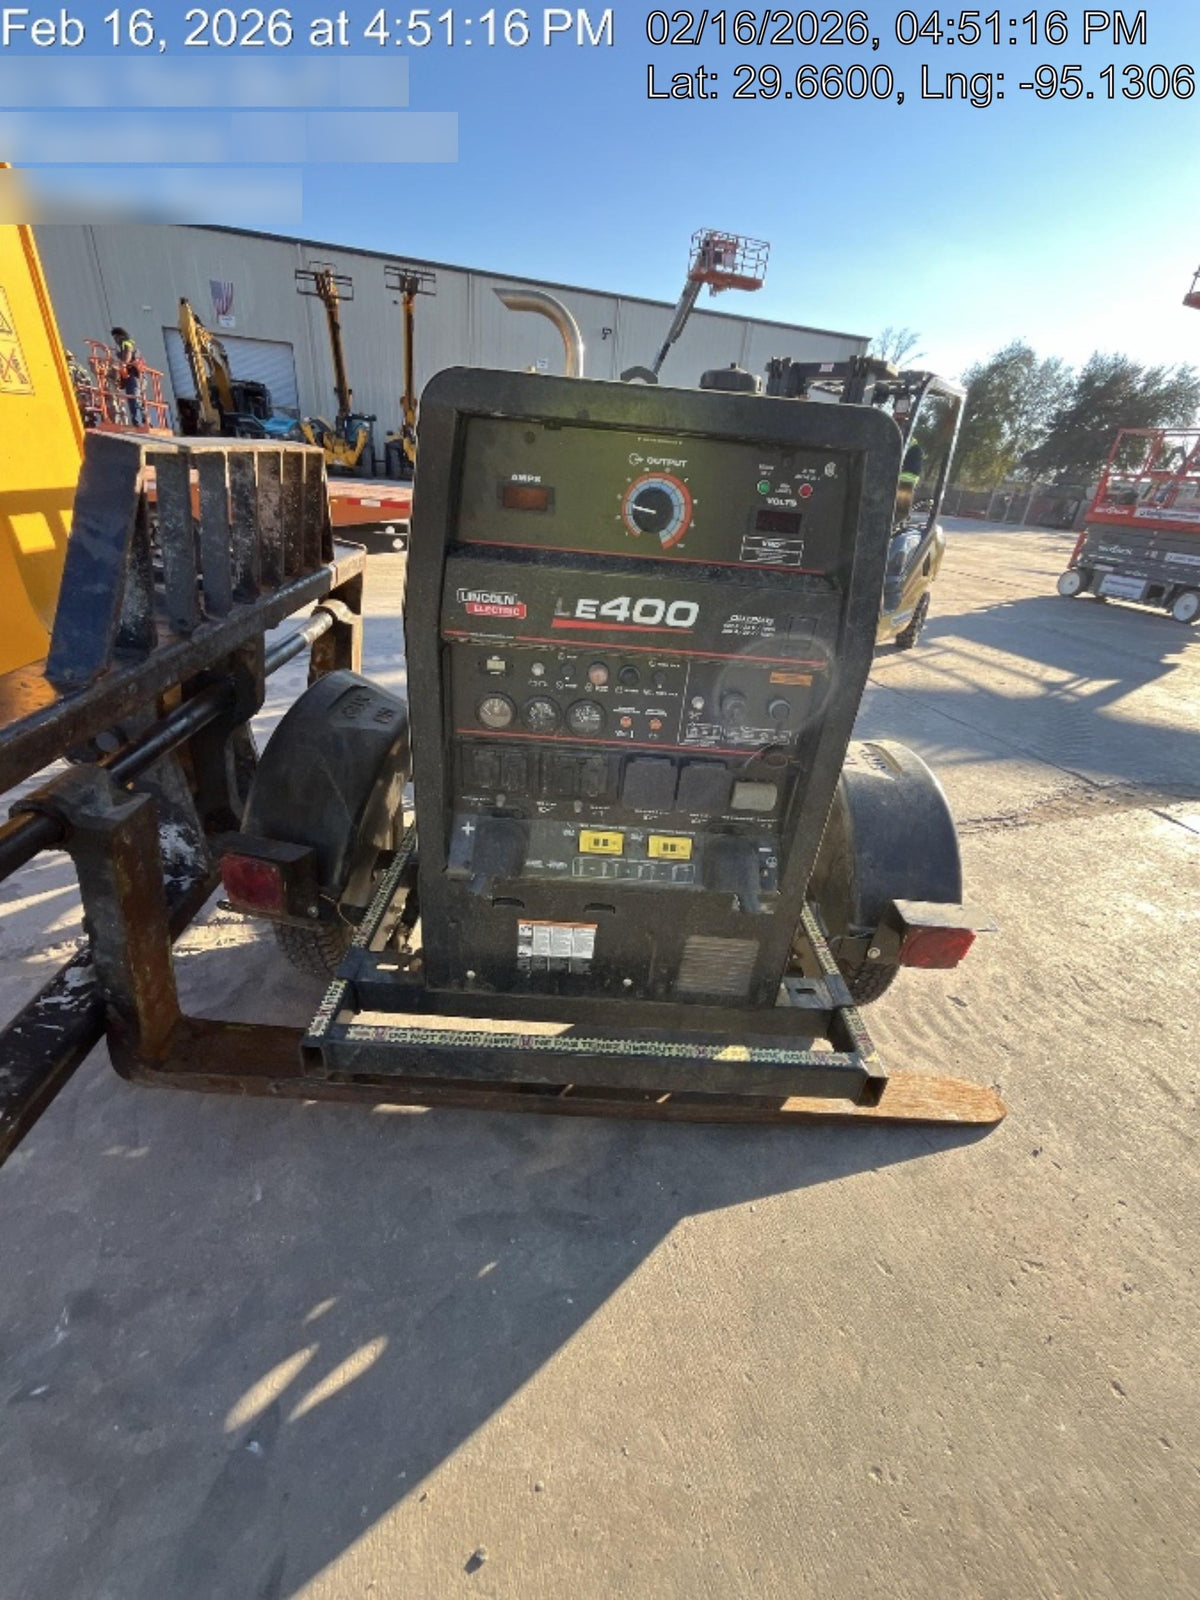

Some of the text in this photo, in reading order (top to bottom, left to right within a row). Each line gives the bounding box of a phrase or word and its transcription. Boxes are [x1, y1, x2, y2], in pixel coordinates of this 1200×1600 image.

[646, 456, 688, 468] OUTPUT
[511, 473, 542, 483] AMPS
[766, 497, 798, 508] VOLTS
[461, 591, 515, 605] LINCOLN
[474, 604, 521, 616] ELECTRIC
